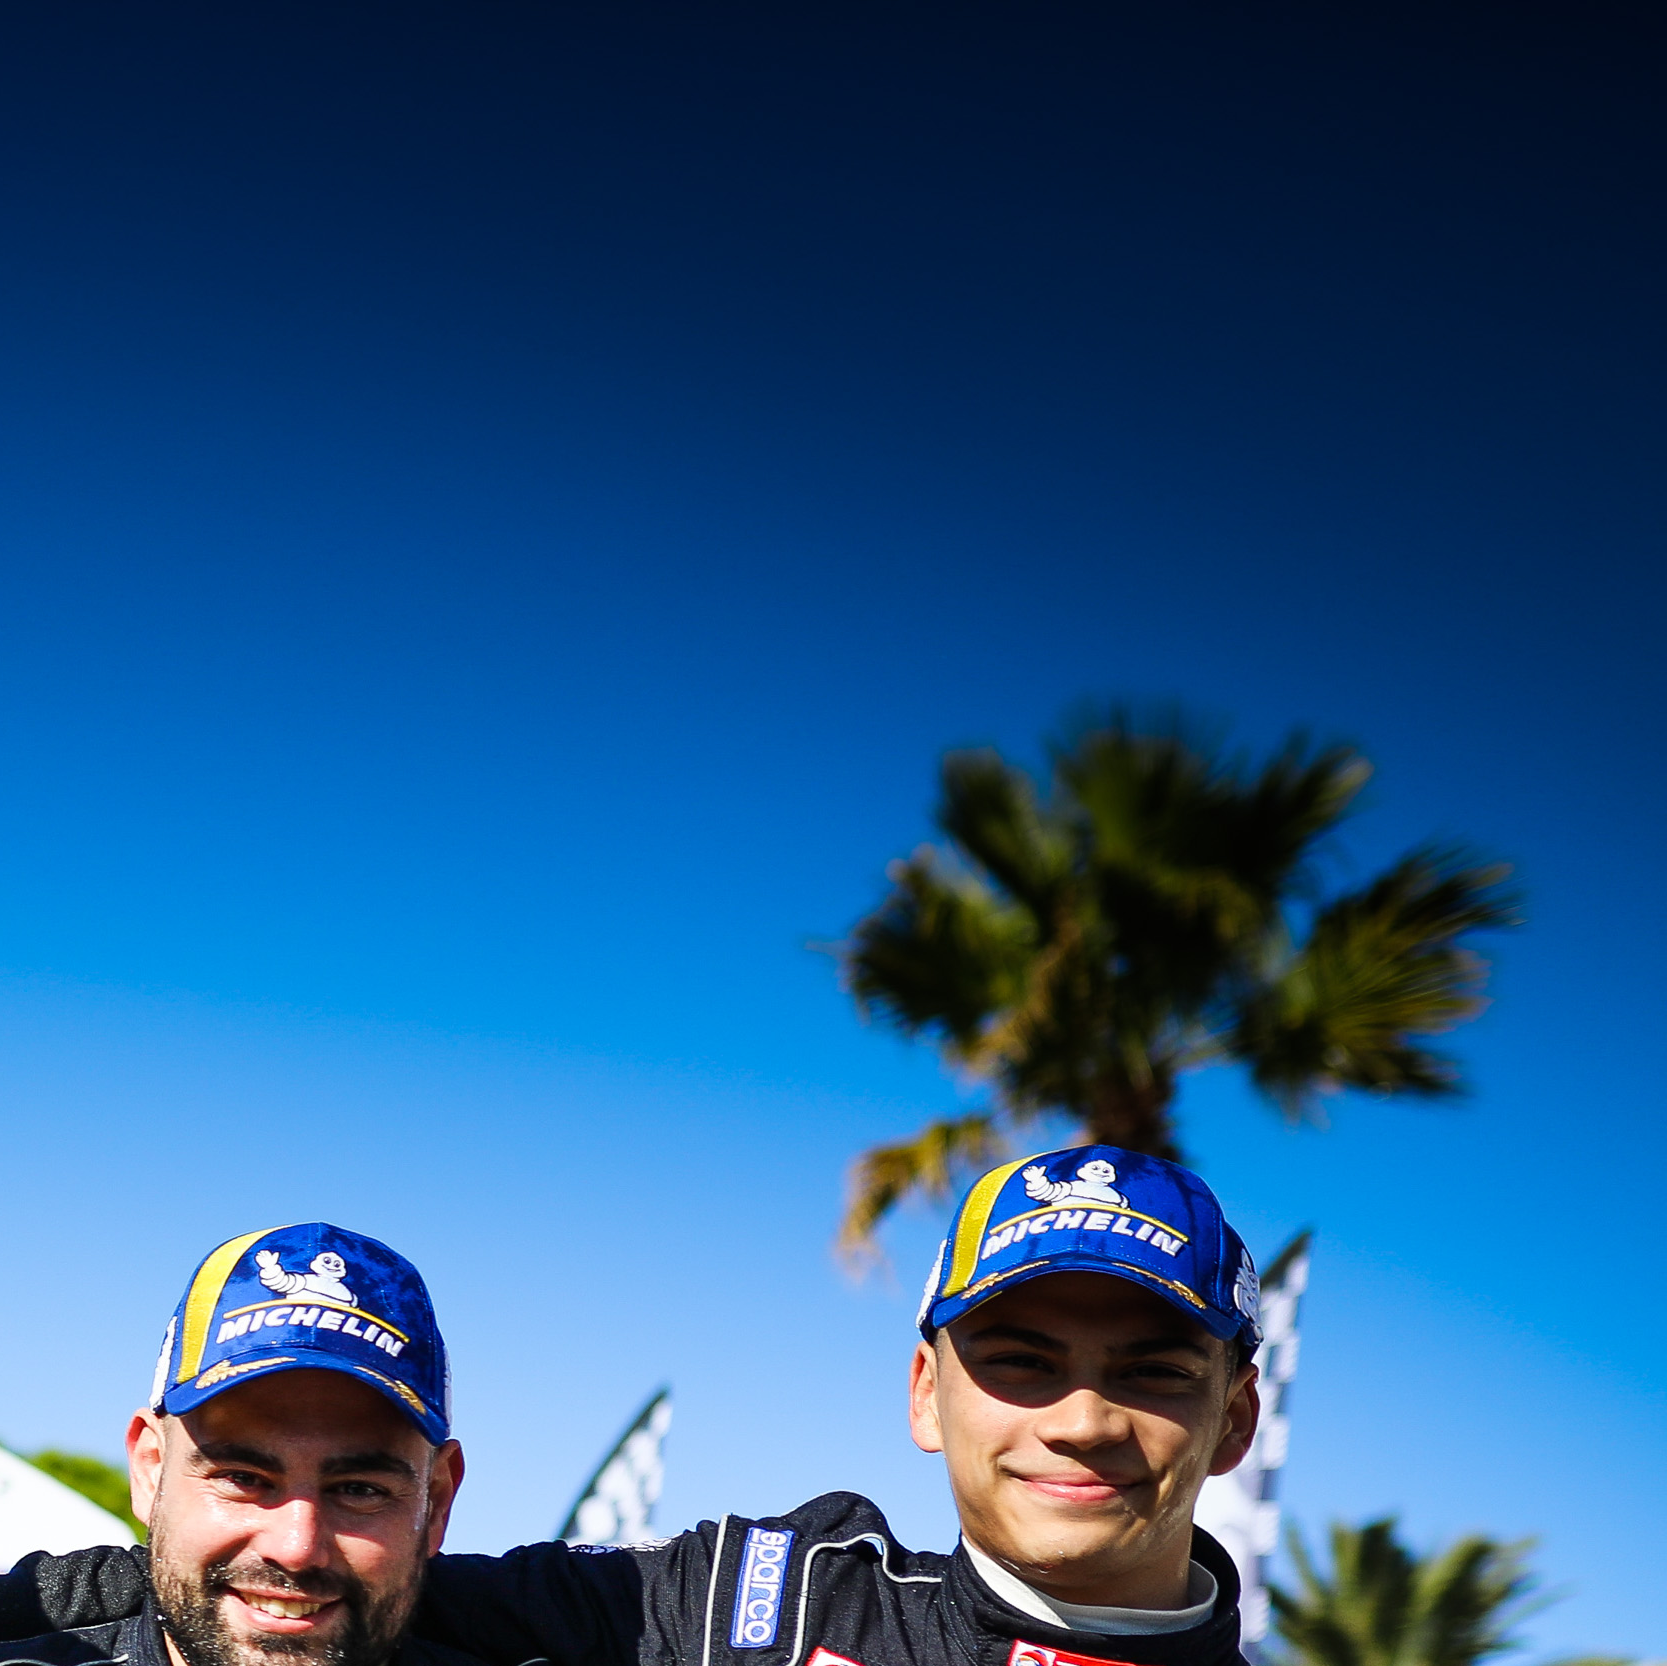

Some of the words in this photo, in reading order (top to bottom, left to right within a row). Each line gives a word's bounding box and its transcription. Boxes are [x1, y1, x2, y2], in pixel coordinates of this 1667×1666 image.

[981, 1209, 1185, 1259] MICHELIN
[216, 1306, 405, 1357] MICHELIN
[749, 1530, 790, 1643] sparco
